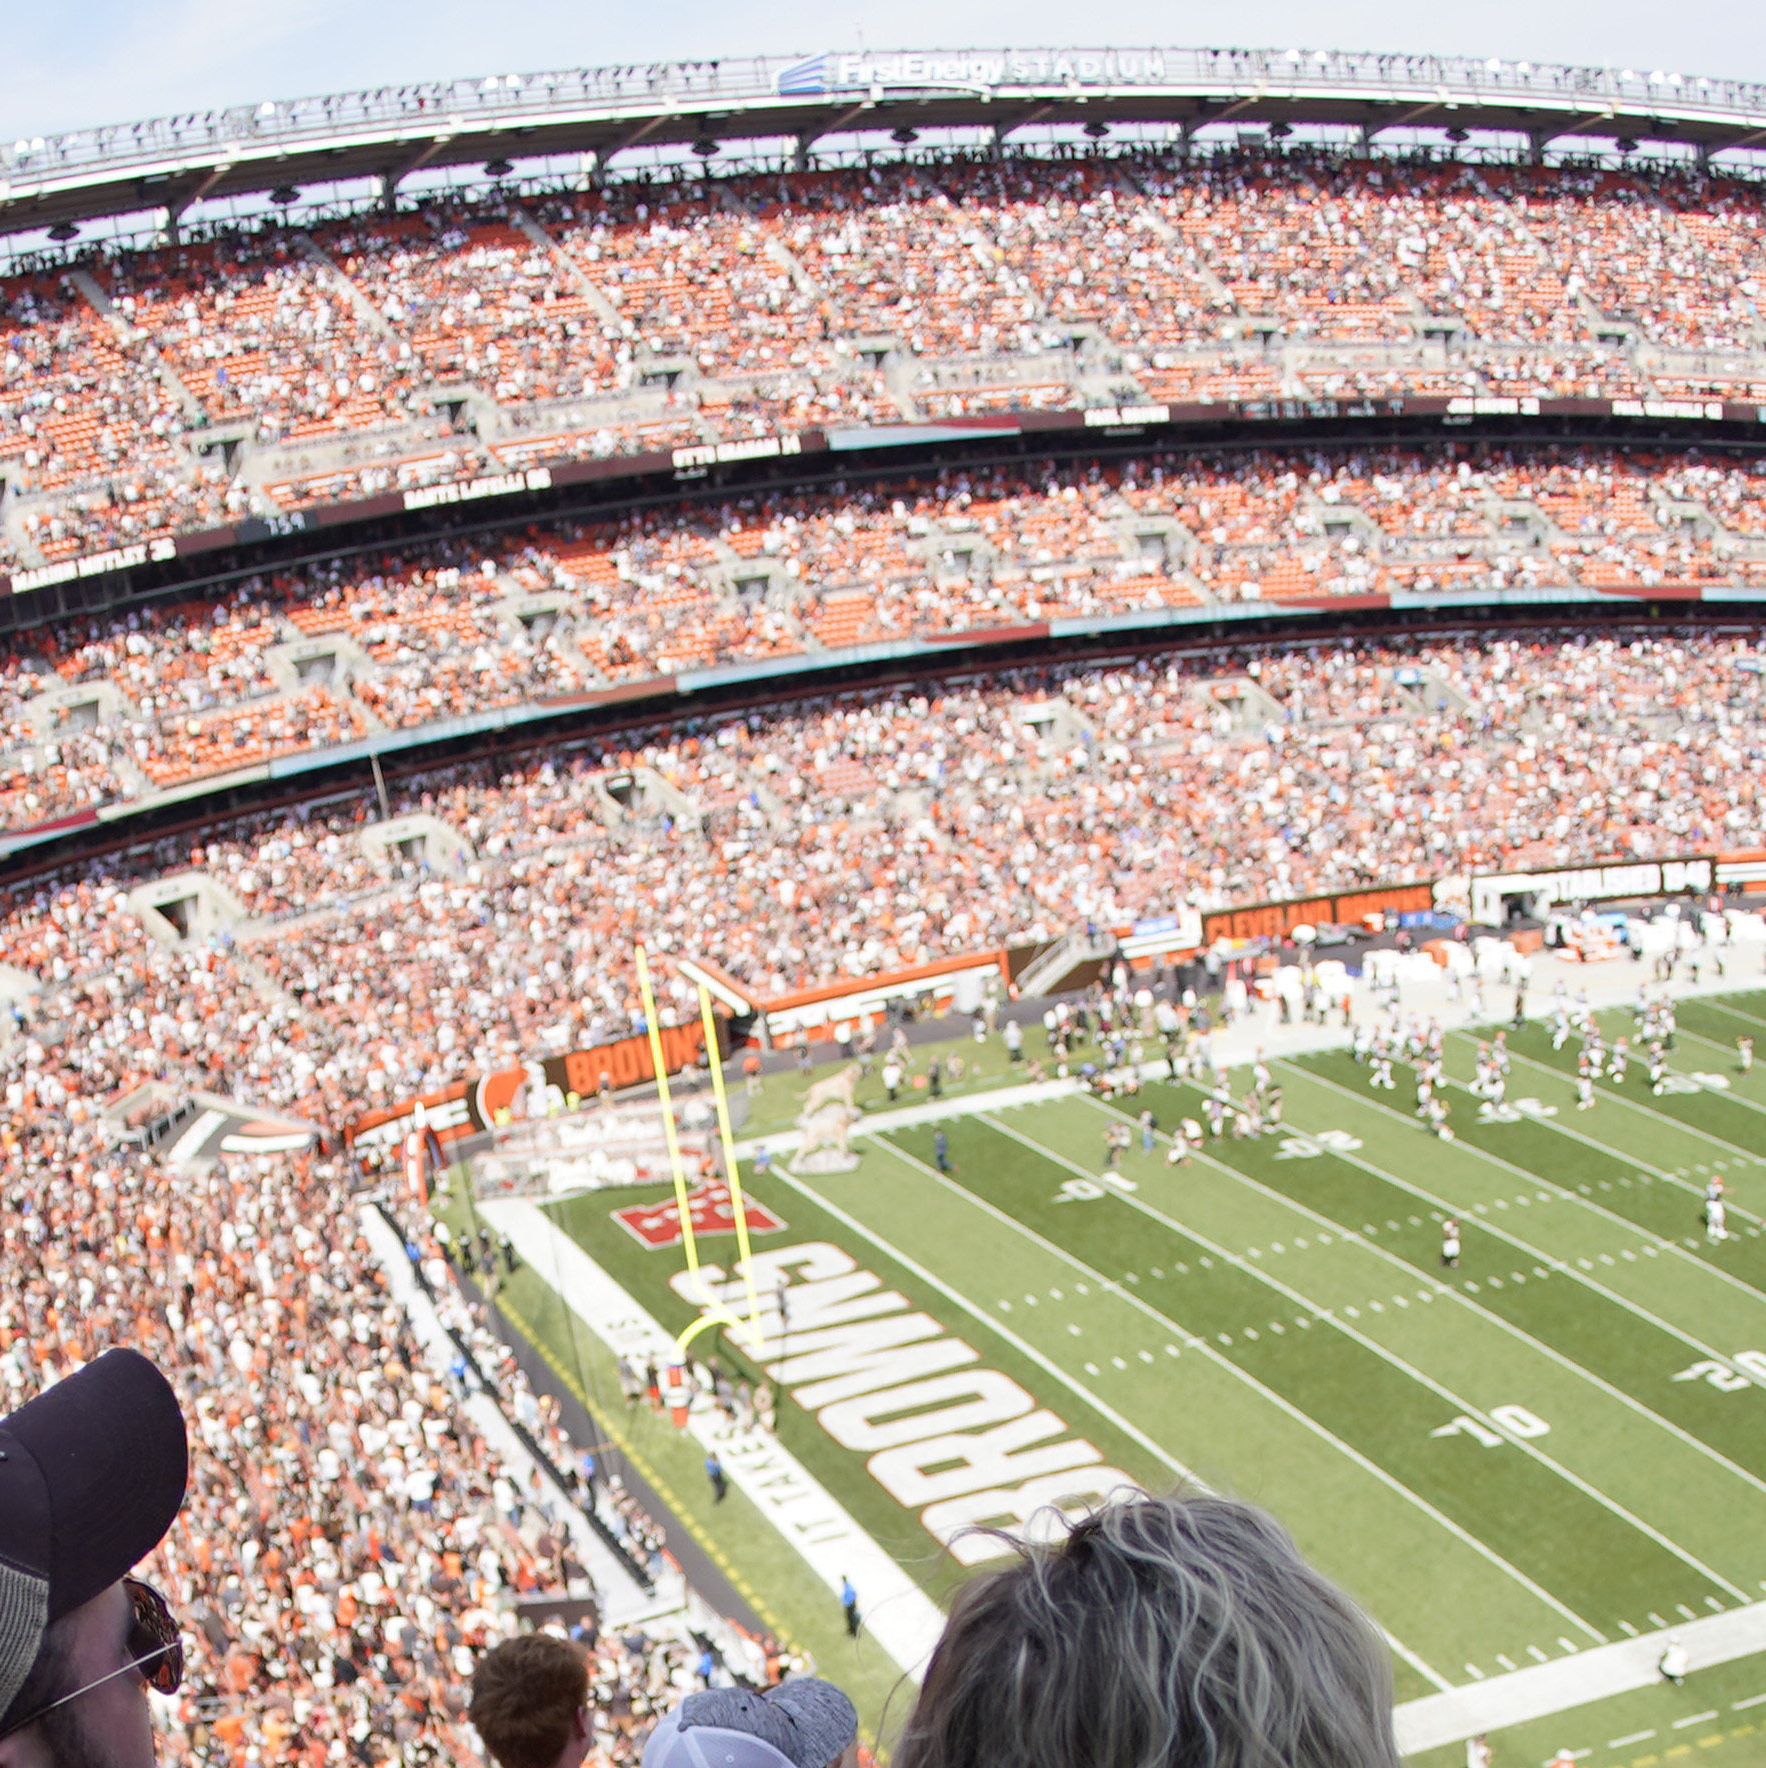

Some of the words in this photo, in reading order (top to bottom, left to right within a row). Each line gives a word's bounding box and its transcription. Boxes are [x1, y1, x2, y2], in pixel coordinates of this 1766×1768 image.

[1010, 54, 1166, 80] STADIUM
[1543, 863, 1661, 905] STABLISHED
[669, 1241, 1155, 1568] BROWNS
[1454, 1403, 1552, 1448] 10
